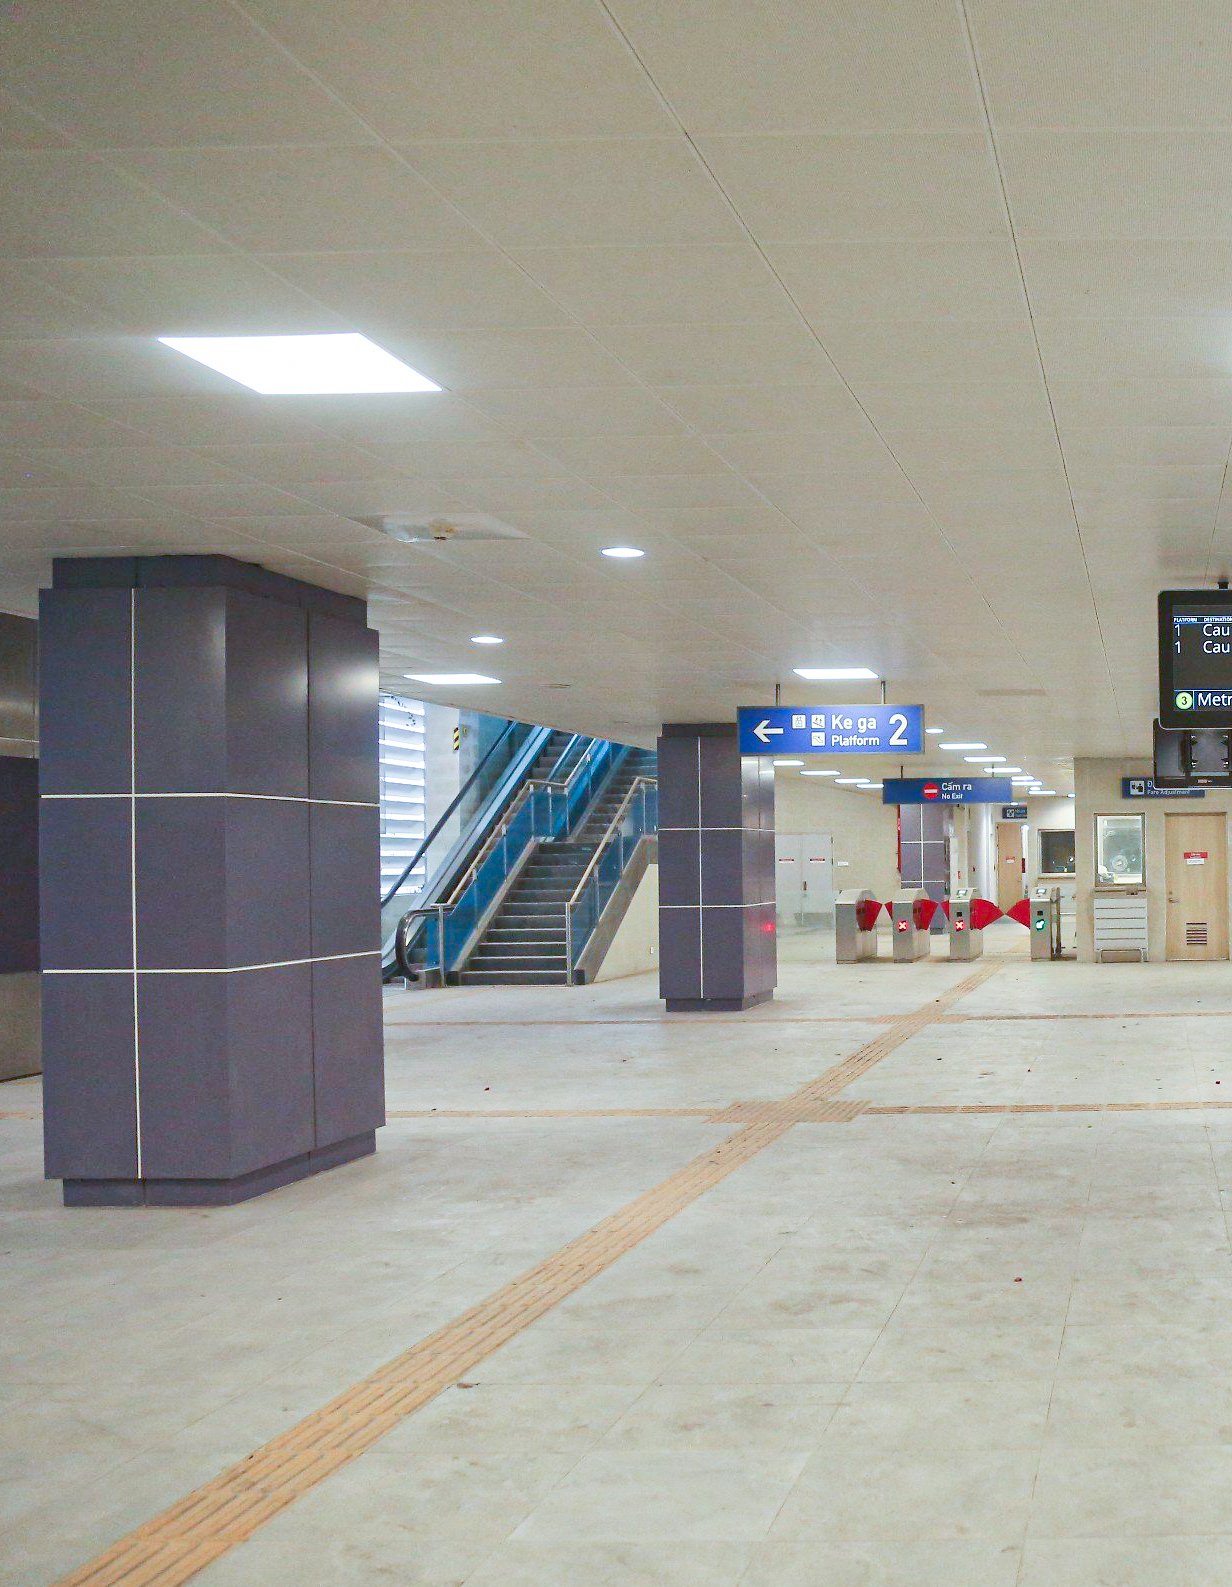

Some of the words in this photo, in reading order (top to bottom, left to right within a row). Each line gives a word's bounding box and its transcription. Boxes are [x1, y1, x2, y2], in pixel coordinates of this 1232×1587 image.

[1174, 624, 1181, 637] 1
[1203, 624, 1230, 637] Cau
[1174, 641, 1181, 654] 1
[1203, 641, 1230, 654] Cau
[1181, 696, 1188, 706] 3
[831, 714, 853, 730] Ke
[857, 717, 877, 733] ga
[889, 713, 908, 746] 2
[831, 734, 880, 747] Platform
[962, 783, 972, 791] ra
